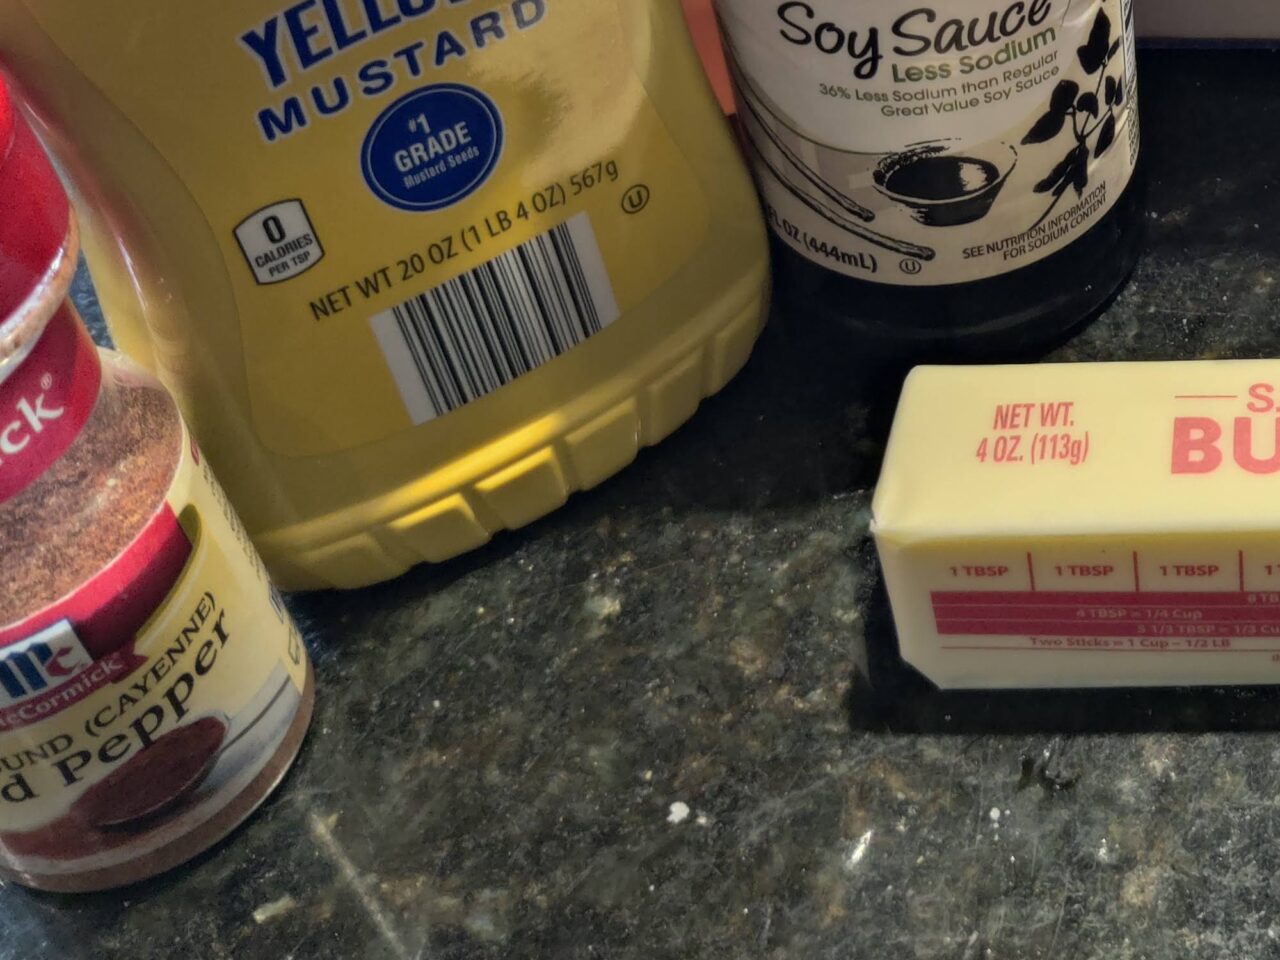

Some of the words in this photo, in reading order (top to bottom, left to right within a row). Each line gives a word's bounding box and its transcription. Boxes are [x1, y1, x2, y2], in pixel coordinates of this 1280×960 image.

[777, 1, 883, 80] Soy
[891, 59, 952, 84] Less
[958, 27, 1058, 75] Sodium
[818, 82, 851, 100] 36%
[854, 86, 889, 103] Less
[893, 83, 958, 103] Sodium
[960, 71, 999, 96] than
[1001, 47, 1060, 89] Regular
[880, 102, 930, 118] Great
[932, 93, 980, 116] Value
[983, 82, 1013, 109] Soy
[1014, 64, 1061, 96] Sauce
[393, 121, 472, 173] GRADE
[407, 112, 431, 135] #1
[402, 160, 446, 190] Mustard
[447, 144, 480, 172] Seeds
[261, 214, 287, 244] 0
[308, 287, 352, 322] NET
[354, 267, 394, 300] WT
[397, 253, 426, 281] 20
[428, 235, 460, 266] OZ
[461, 225, 482, 253] (1
[484, 210, 513, 239] LB
[515, 200, 532, 220] 4
[531, 183, 567, 213] OZ)
[568, 158, 620, 197] 567g
[962, 244, 985, 260] SEE
[986, 223, 1047, 254] NUTRITION
[1046, 180, 1107, 229] INFORMATION
[1002, 244, 1027, 262] FOR
[1027, 224, 1066, 254] SODIUM
[1065, 193, 1108, 235] CONTENT
[255, 232, 314, 269] CALORIES
[268, 258, 291, 278] PER
[291, 250, 313, 270] TSP
[782, 218, 801, 244] OZ
[803, 232, 878, 274] (444mL)
[993, 402, 1035, 431] NET
[1039, 401, 1076, 429] WT.
[976, 436, 990, 463] 4
[991, 434, 1026, 464] OZ.
[1028, 431, 1090, 466] (113g)
[962, 565, 1009, 578] TBSP
[1066, 564, 1115, 577] TBSP
[1171, 564, 1219, 577] TBSP
[1172, 609, 1203, 621] Cup
[1139, 638, 1169, 650] Cup
[0, 733, 74, 773] UND
[84, 591, 216, 738] (CAYENNE)
[0, 651, 125, 730] cCormick
[52, 607, 231, 788] Pepper
